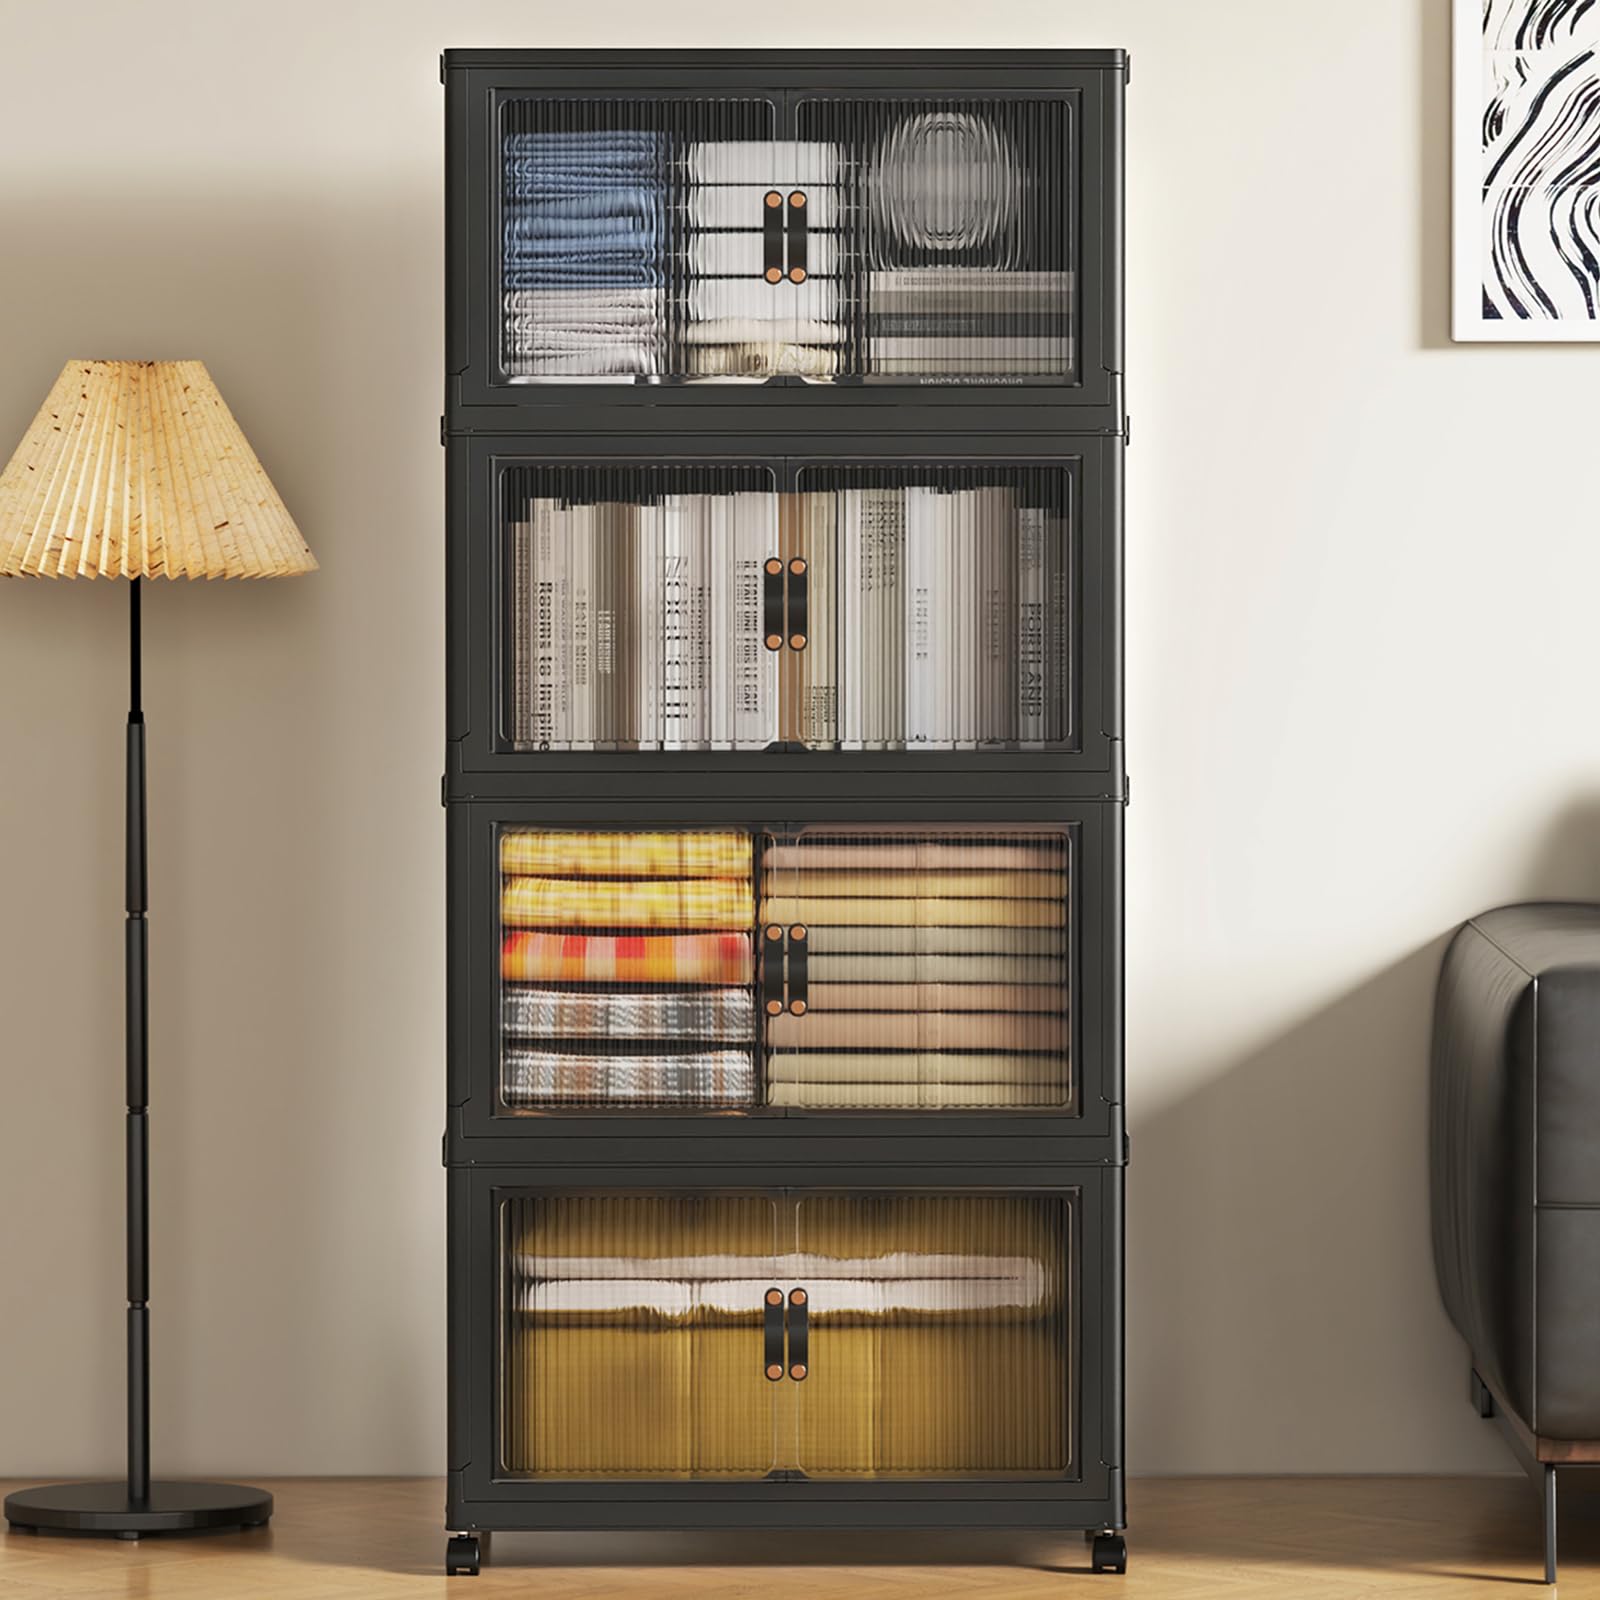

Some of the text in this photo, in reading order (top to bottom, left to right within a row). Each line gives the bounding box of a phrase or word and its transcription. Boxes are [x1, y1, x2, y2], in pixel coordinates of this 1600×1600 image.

[538, 582, 552, 649] Rooms
[538, 656, 552, 677] to
[1021, 602, 1042, 717] PORTLAND
